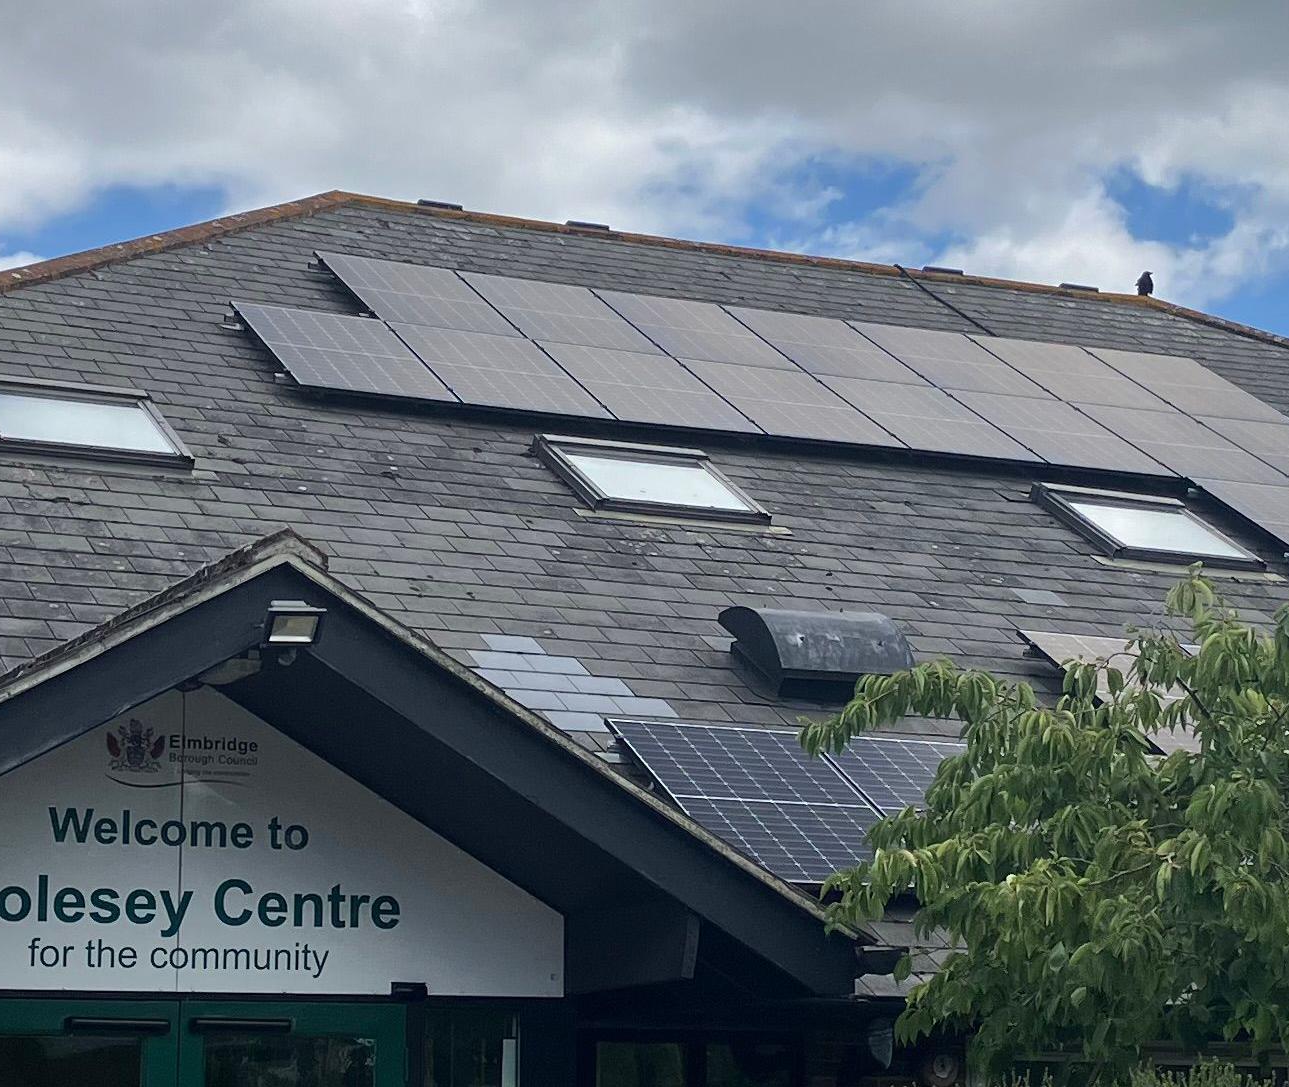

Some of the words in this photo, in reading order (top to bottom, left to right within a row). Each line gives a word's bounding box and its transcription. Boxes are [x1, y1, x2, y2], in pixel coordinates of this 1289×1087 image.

[169, 735, 258, 755] Elmbridge
[169, 753, 214, 766] Borough
[218, 754, 258, 766] Council
[48, 806, 254, 849] Welcome
[267, 816, 310, 851] to
[214, 878, 401, 930] Centre
[28, 937, 75, 968] for
[85, 938, 138, 969] the
[150, 942, 330, 979] community
